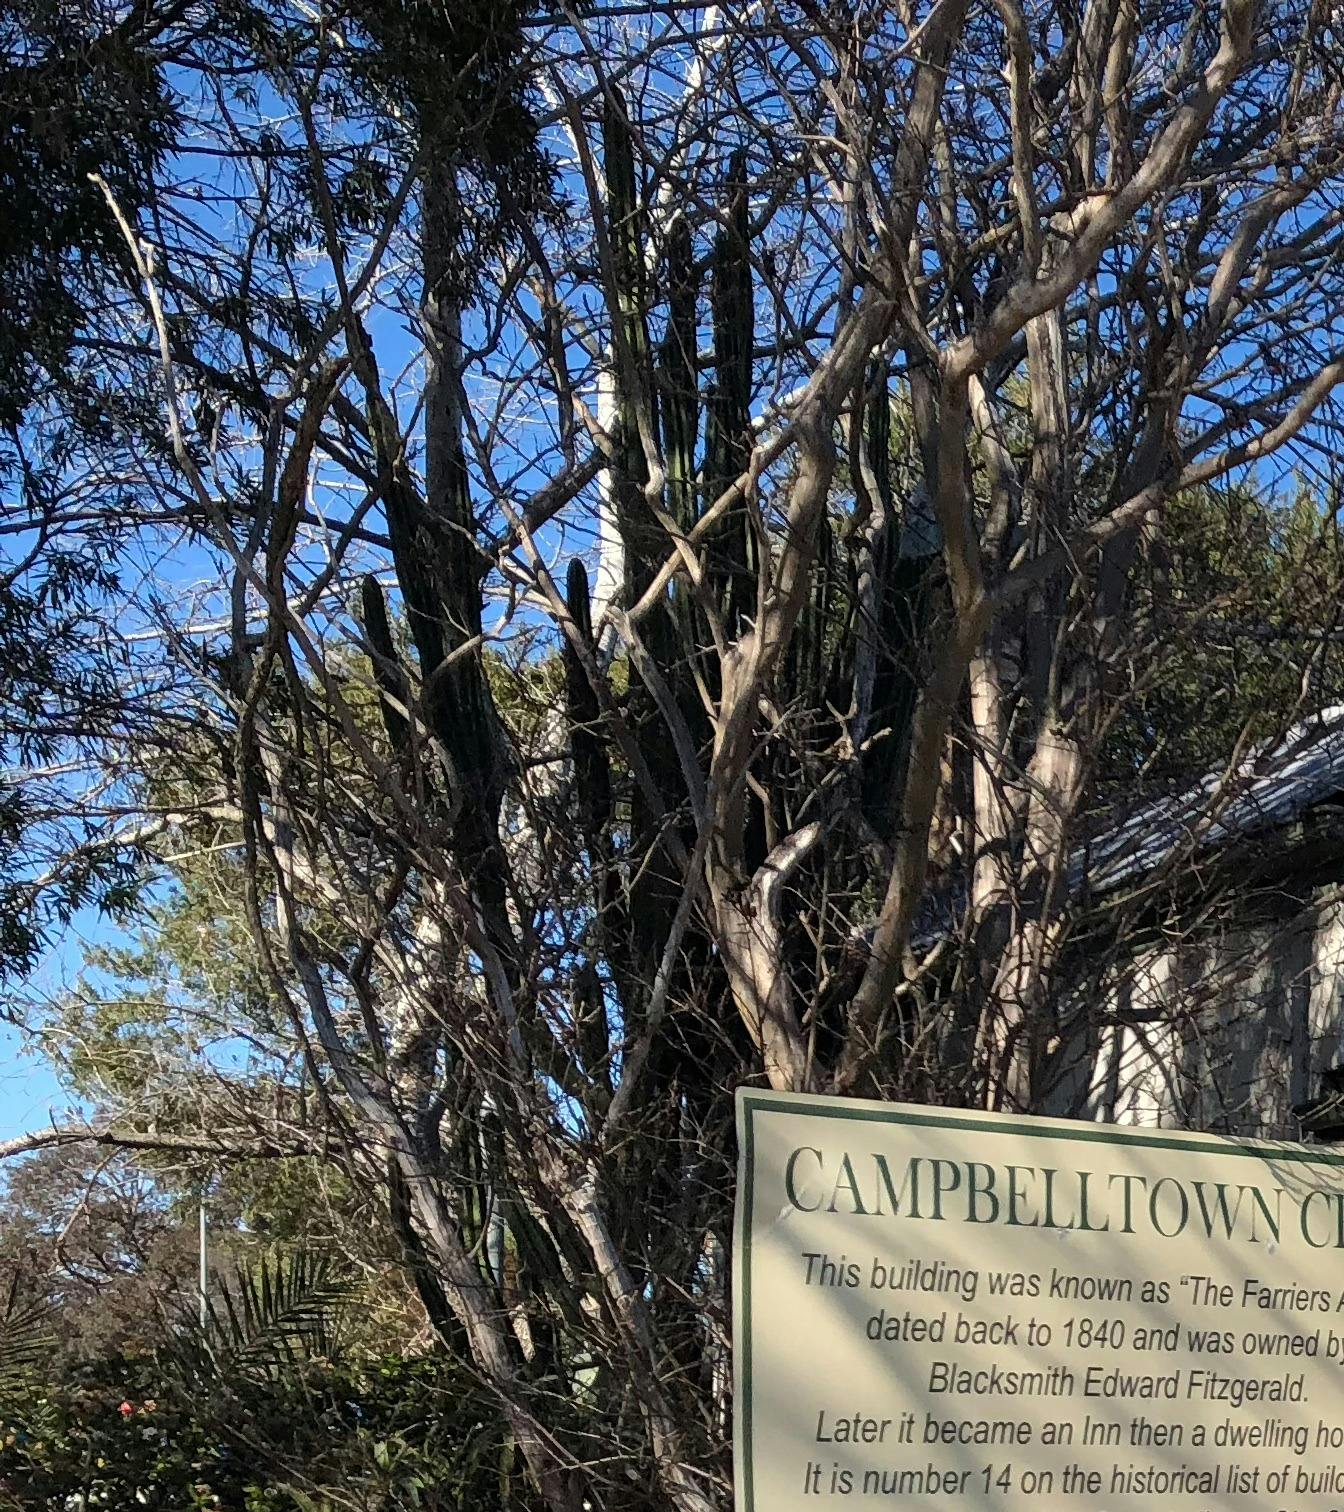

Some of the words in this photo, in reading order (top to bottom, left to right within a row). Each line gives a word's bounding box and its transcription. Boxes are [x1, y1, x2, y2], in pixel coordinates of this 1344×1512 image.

[784, 1146, 1284, 1244] CAMPBELLTOWN
[801, 1253, 861, 1288] This
[870, 1257, 979, 1301] building
[988, 1274, 1040, 1298] was
[1049, 1268, 1132, 1301] known
[1141, 1280, 1171, 1303] as
[1241, 1279, 1332, 1312] Farriers
[866, 1310, 947, 1342] dated
[954, 1314, 1018, 1345] back
[1027, 1318, 1051, 1347] to
[1063, 1318, 1125, 1350] 1840
[1133, 1323, 1179, 1353] and
[1187, 1332, 1234, 1356] was
[1242, 1330, 1319, 1358] owned
[928, 1361, 1075, 1397] Blacksmith
[1084, 1366, 1180, 1400] Edward
[1186, 1370, 1309, 1407] Fitzgerald.
[816, 1410, 891, 1444] Later
[899, 1412, 919, 1444] it
[923, 1413, 1032, 1445] became
[1041, 1420, 1073, 1446] an
[1081, 1415, 1121, 1446] Inn
[1129, 1417, 1184, 1448] then
[1191, 1423, 1206, 1448] a
[1214, 1418, 1309, 1455] dwelling
[803, 1462, 822, 1495] It
[830, 1462, 854, 1495] is
[863, 1462, 971, 1495] number
[981, 1463, 1012, 1494] 14
[1020, 1469, 1054, 1495] on
[1062, 1464, 1102, 1494] the
[1109, 1463, 1220, 1495] historical
[1226, 1464, 1260, 1495] list
[1265, 1463, 1290, 1494] of
